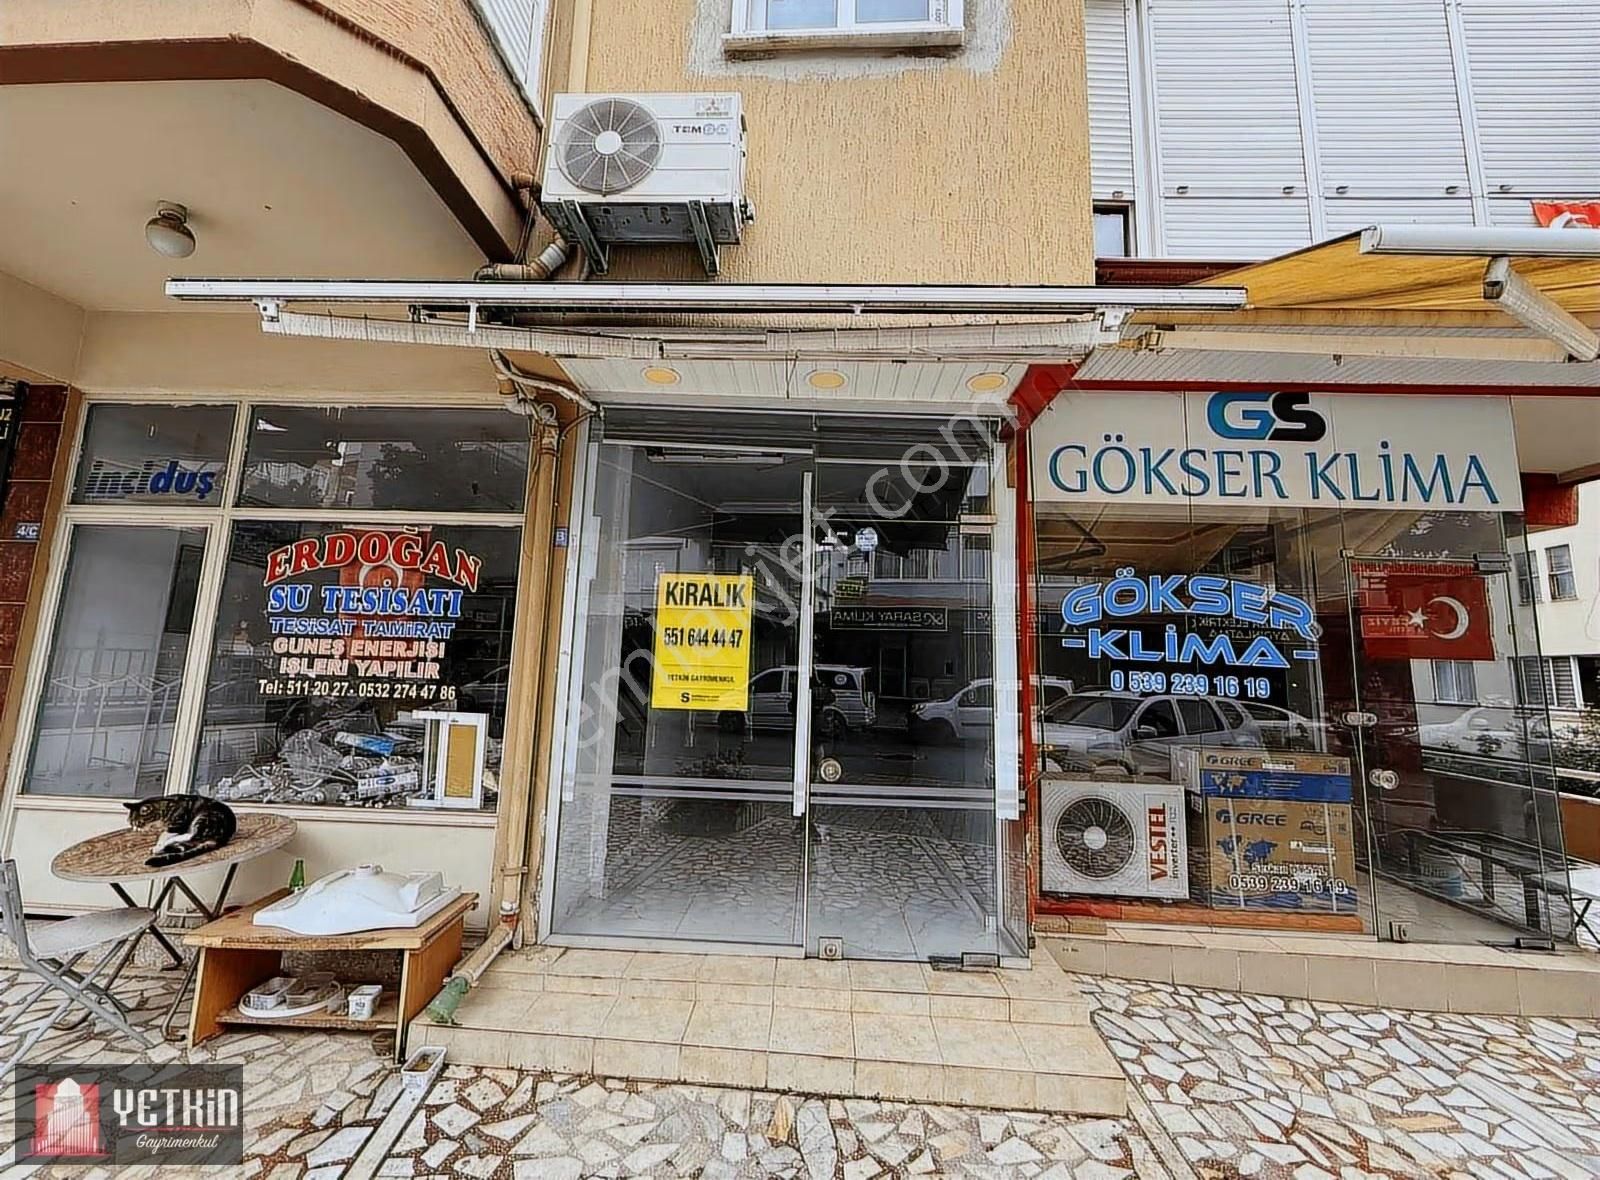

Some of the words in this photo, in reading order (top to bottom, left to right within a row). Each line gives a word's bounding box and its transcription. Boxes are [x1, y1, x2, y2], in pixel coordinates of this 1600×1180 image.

[1207, 391, 1327, 442] GS
[1049, 433, 1288, 499] GÖKSER
[1305, 440, 1502, 505] KLİMA
[264, 525, 481, 592] ERDOĞAN
[268, 584, 313, 613] SU
[321, 578, 464, 617] TESİSATI
[1061, 567, 1317, 642] GÖKSER
[664, 627, 685, 647] 551
[687, 627, 709, 648] 644
[711, 628, 726, 648] 44
[728, 629, 743, 649] 47
[354, 659, 440, 679] YAPILIR
[1110, 669, 1125, 692] 0
[1128, 670, 1166, 694] 539
[1171, 672, 1209, 695] 239
[1213, 675, 1240, 698] 16
[1243, 676, 1271, 699] 19
[258, 679, 284, 695] Tel:
[286, 680, 309, 696] 511
[312, 681, 329, 696] 20
[358, 682, 390, 698] 0532
[393, 683, 417, 699] 274
[420, 684, 437, 699] 47
[439, 685, 457, 700] 86
[1220, 754, 1256, 767] GREE
[1236, 812, 1288, 827] GREE
[1148, 802, 1169, 881] VESTEL
[1229, 873, 1268, 891] 0539
[1271, 874, 1301, 892] 239
[1302, 877, 1324, 894] 16
[1326, 878, 1347, 895] 19
